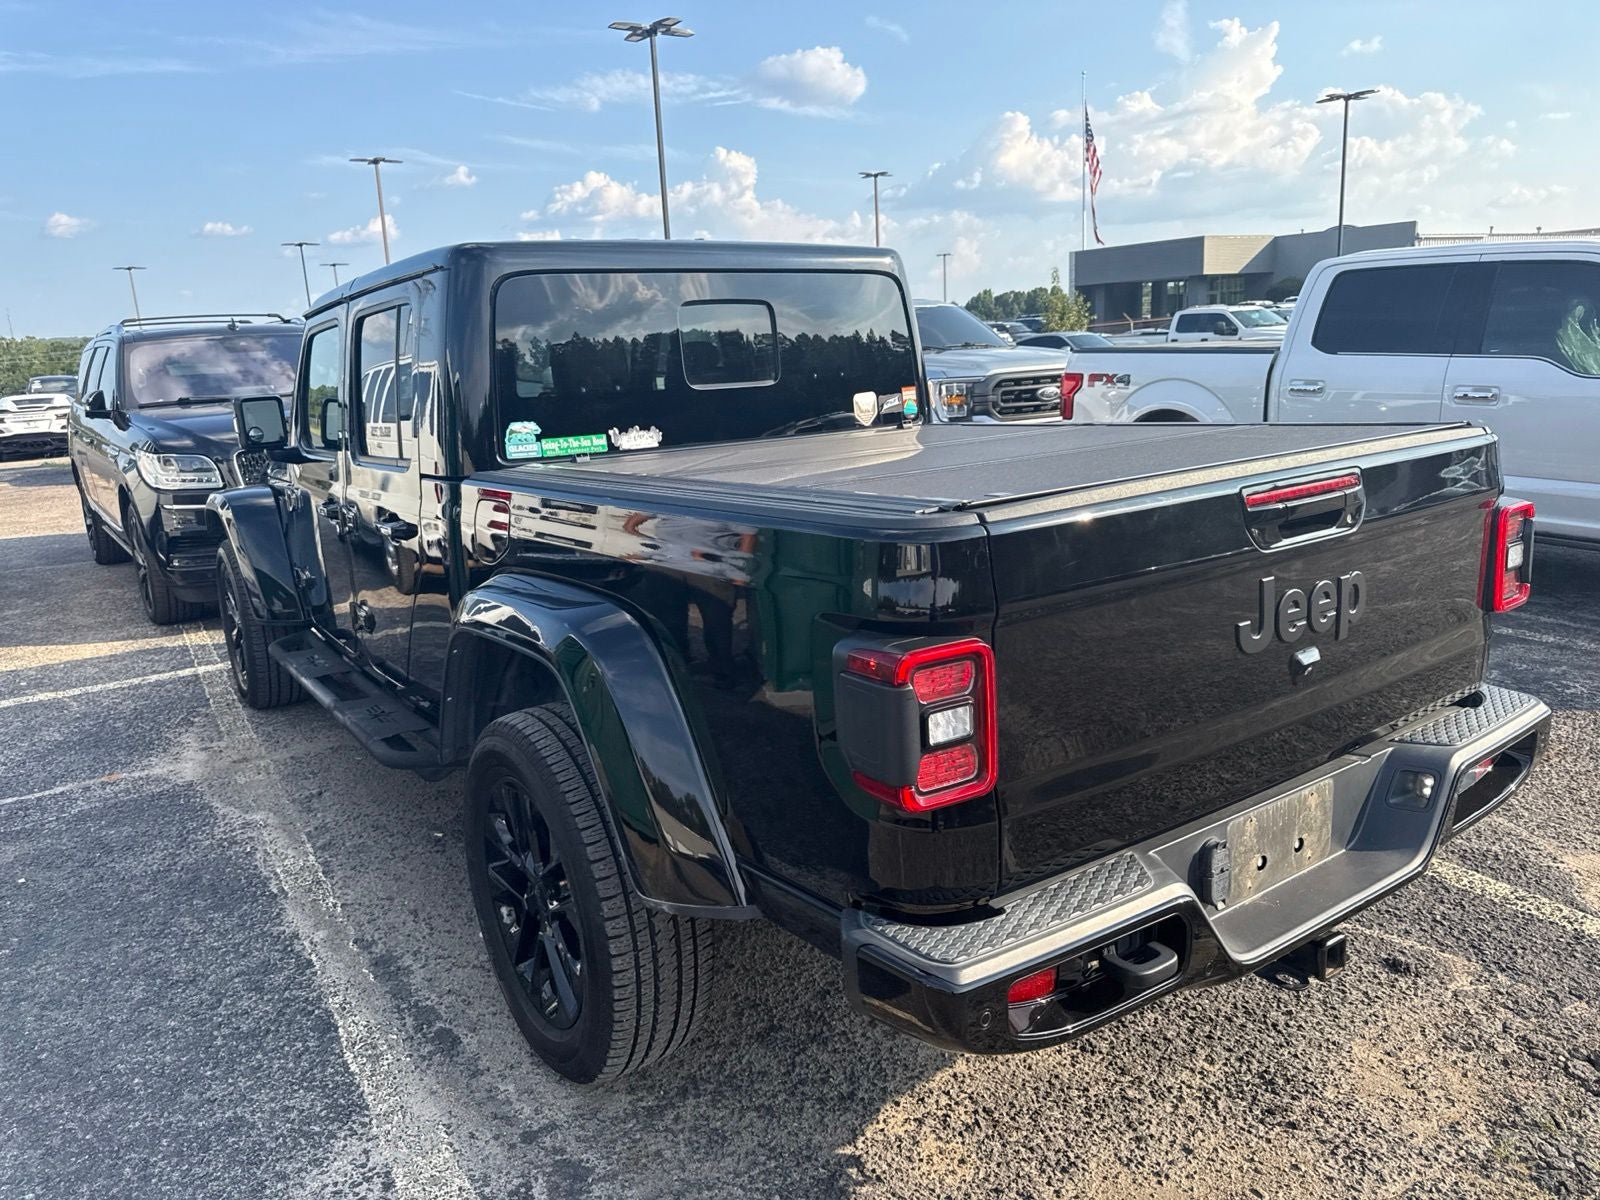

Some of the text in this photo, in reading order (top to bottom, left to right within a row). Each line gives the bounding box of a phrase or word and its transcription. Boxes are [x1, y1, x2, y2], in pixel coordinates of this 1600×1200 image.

[1087, 373, 1131, 387] FX4
[508, 443, 538, 453] GLACIER
[1234, 570, 1367, 654] Jeep
